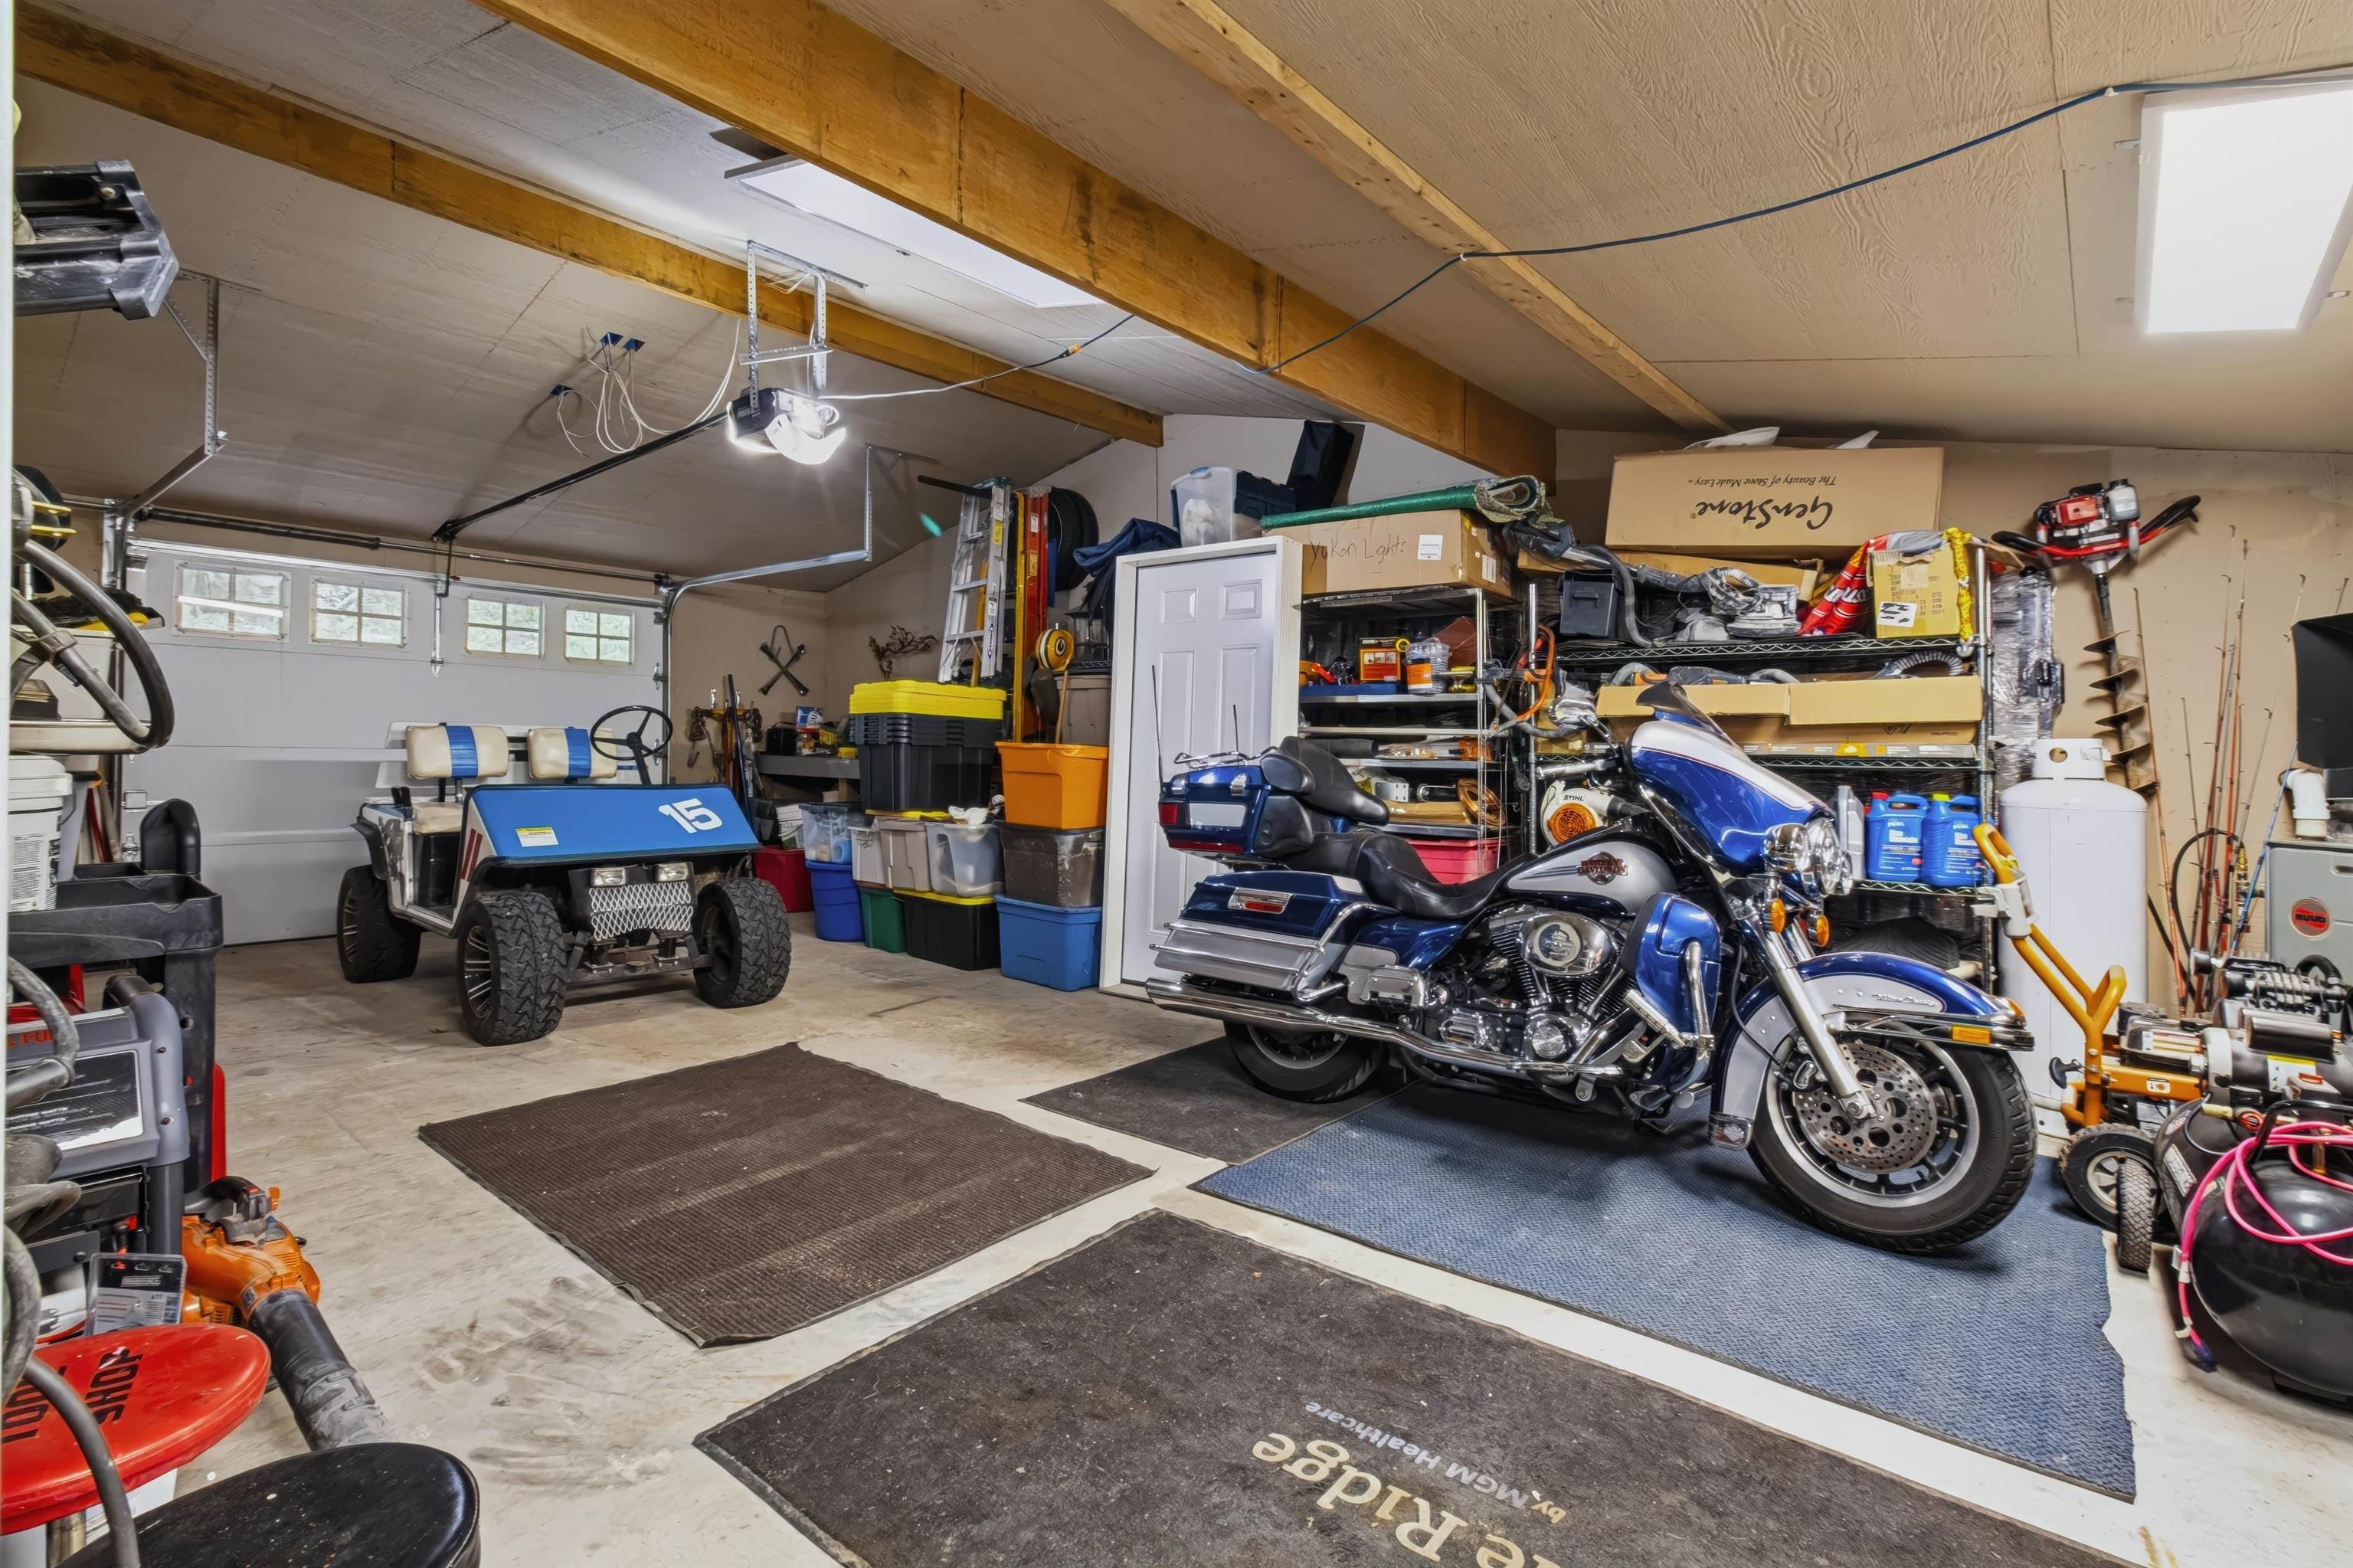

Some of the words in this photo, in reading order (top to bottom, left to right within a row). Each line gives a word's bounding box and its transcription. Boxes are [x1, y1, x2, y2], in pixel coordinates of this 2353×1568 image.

[1716, 477, 1743, 487] Made
[1743, 476, 1769, 487] Stone
[1766, 474, 1782, 488] of
[1782, 473, 1818, 486] Beauty
[1818, 475, 1837, 486] The
[1694, 495, 1833, 530] GenStone
[657, 797, 723, 834] 15
[1305, 1402, 1442, 1470] Healthcare
[1252, 1432, 1468, 1562] Ridge
[1445, 1462, 1530, 1508] MGM
